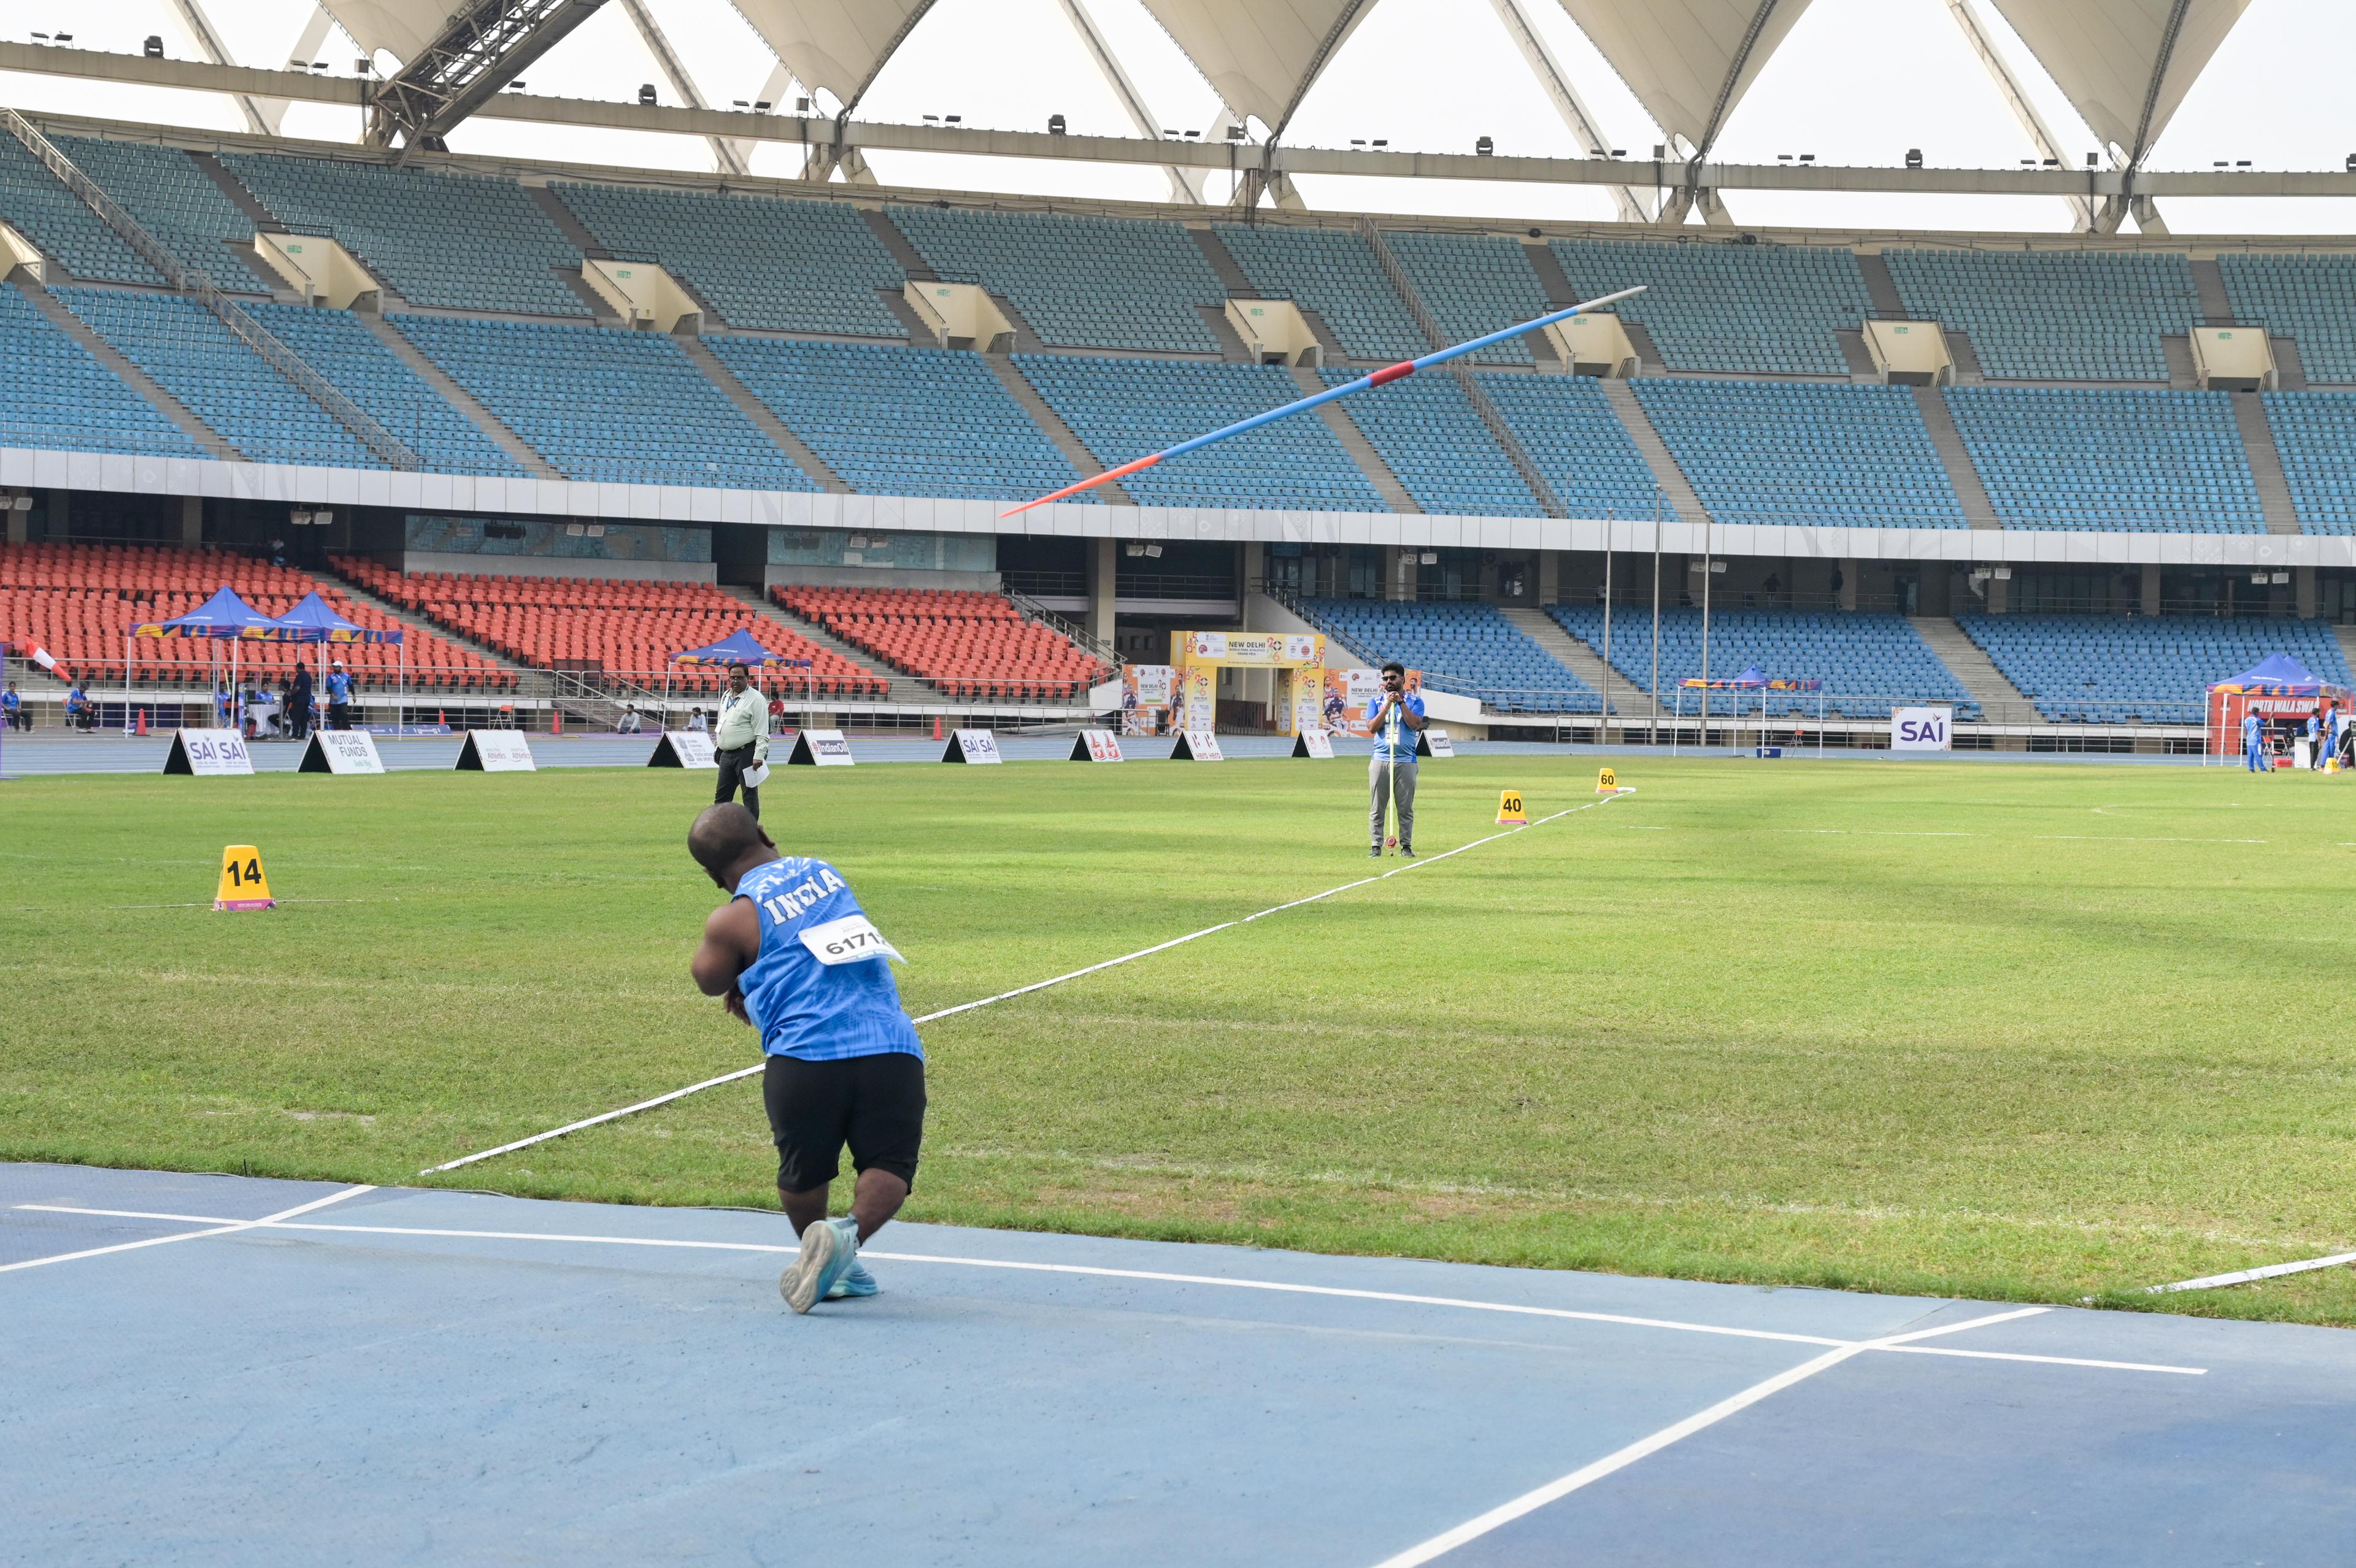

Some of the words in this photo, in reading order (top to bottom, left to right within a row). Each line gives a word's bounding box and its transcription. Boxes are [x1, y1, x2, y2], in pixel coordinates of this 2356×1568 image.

[2247, 700, 2273, 712] NORTH
[2273, 700, 2296, 713] WALA
[1900, 721, 1943, 742] SAI
[328, 735, 363, 745] MUTUAL
[963, 740, 980, 753] SAI
[980, 739, 996, 753] SAI
[190, 742, 217, 760] SAI
[219, 742, 246, 760] SAI
[339, 747, 368, 757] FUNDS
[818, 742, 848, 753] IndianOil
[1601, 774, 1614, 785] 60
[1503, 798, 1522, 812] 40
[227, 858, 262, 886] 14
[762, 868, 845, 926] INDIA
